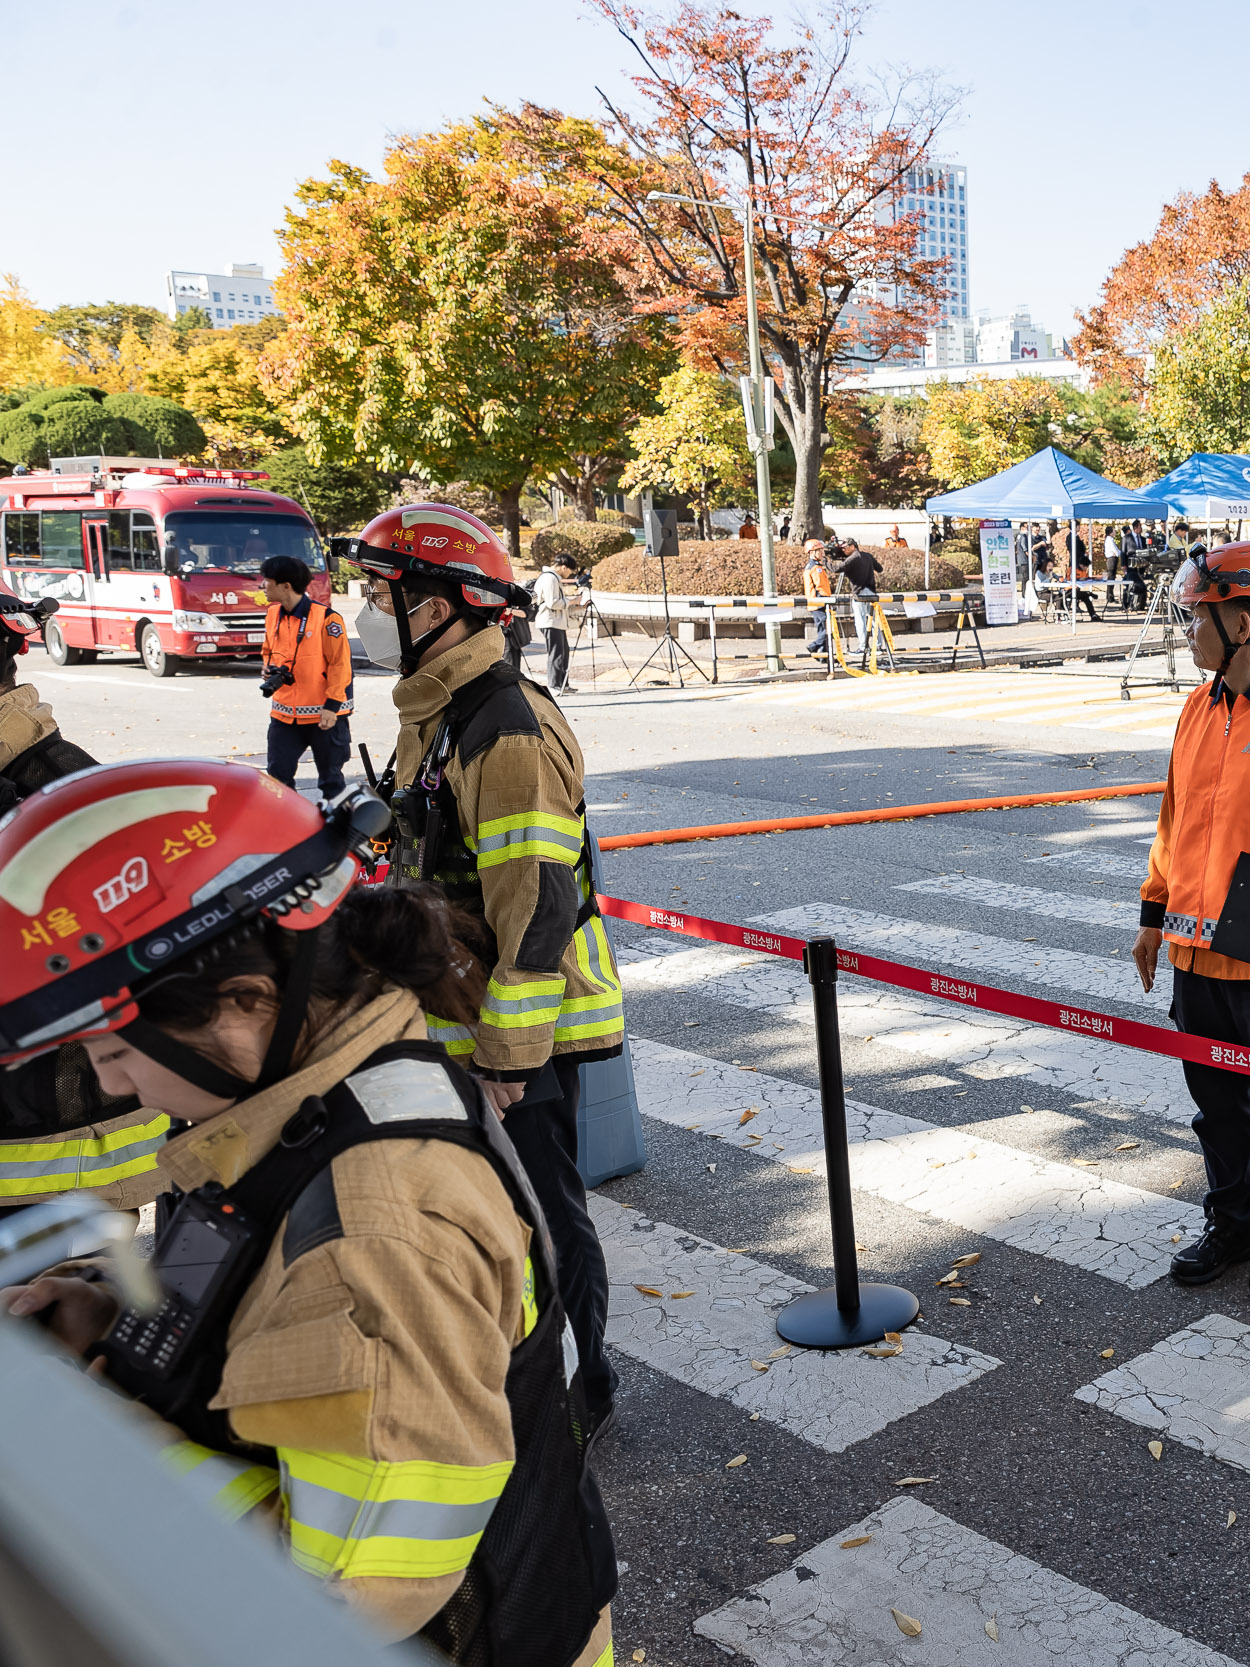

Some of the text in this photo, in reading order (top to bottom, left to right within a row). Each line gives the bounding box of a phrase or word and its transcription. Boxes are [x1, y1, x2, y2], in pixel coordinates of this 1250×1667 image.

[1227, 505, 1248, 514] 2023
[391, 528, 477, 554] 서울 119 소방
[986, 537, 1009, 550] 안전
[989, 572, 1011, 584] 훈련
[210, 591, 239, 605] 서울
[160, 820, 217, 864] 소방
[93, 856, 149, 913] 119
[19, 906, 82, 950] 서울
[649, 910, 685, 930] 광진소방서
[742, 931, 782, 952] 광진소방서
[930, 977, 977, 1002] 광진소방서
[1059, 1009, 1113, 1036] 광진소방서
